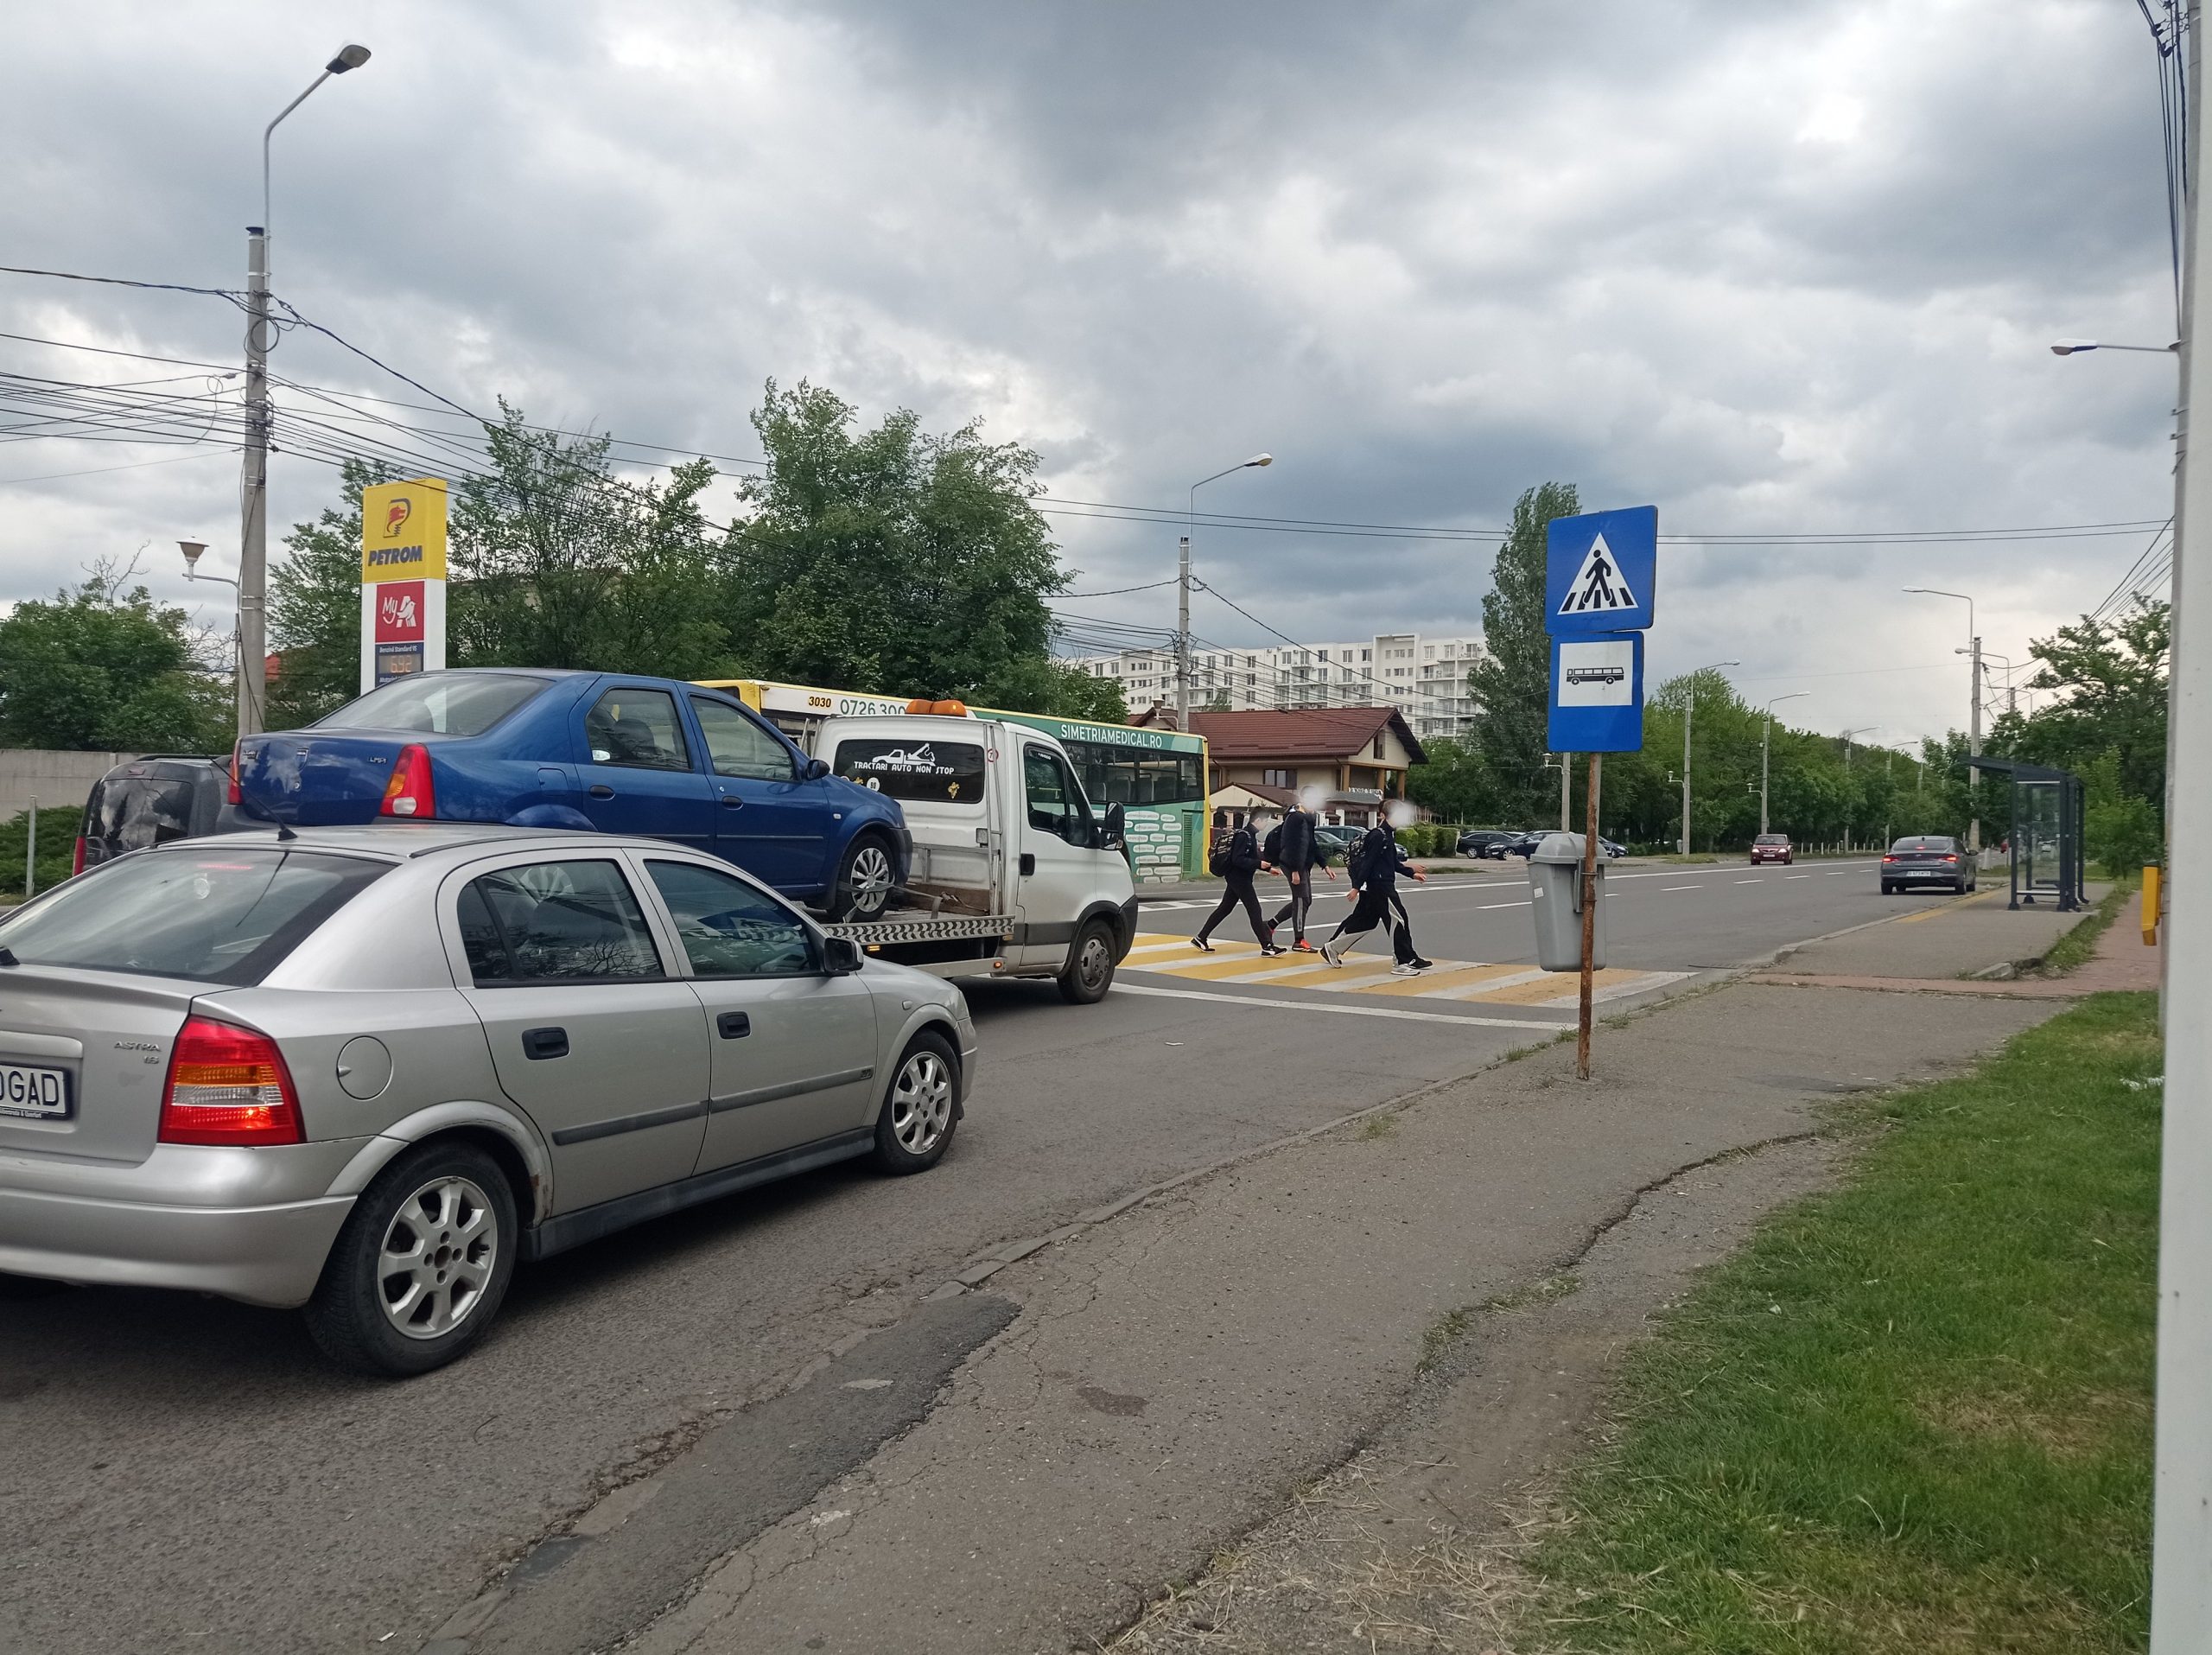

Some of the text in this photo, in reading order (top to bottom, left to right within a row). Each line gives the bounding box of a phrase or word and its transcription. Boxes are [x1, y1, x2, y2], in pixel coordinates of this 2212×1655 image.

[367, 545, 423, 566] PETROM
[382, 596, 398, 625] My
[808, 696, 832, 708] 3030
[840, 698, 876, 716] 0726
[1061, 723, 1163, 749] SIMETRIAMEDICAL.RO
[854, 761, 888, 771] TRACTARI
[891, 764, 912, 773] AUTO
[935, 766, 955, 775] STOP
[113, 1041, 162, 1052] ASTRA
